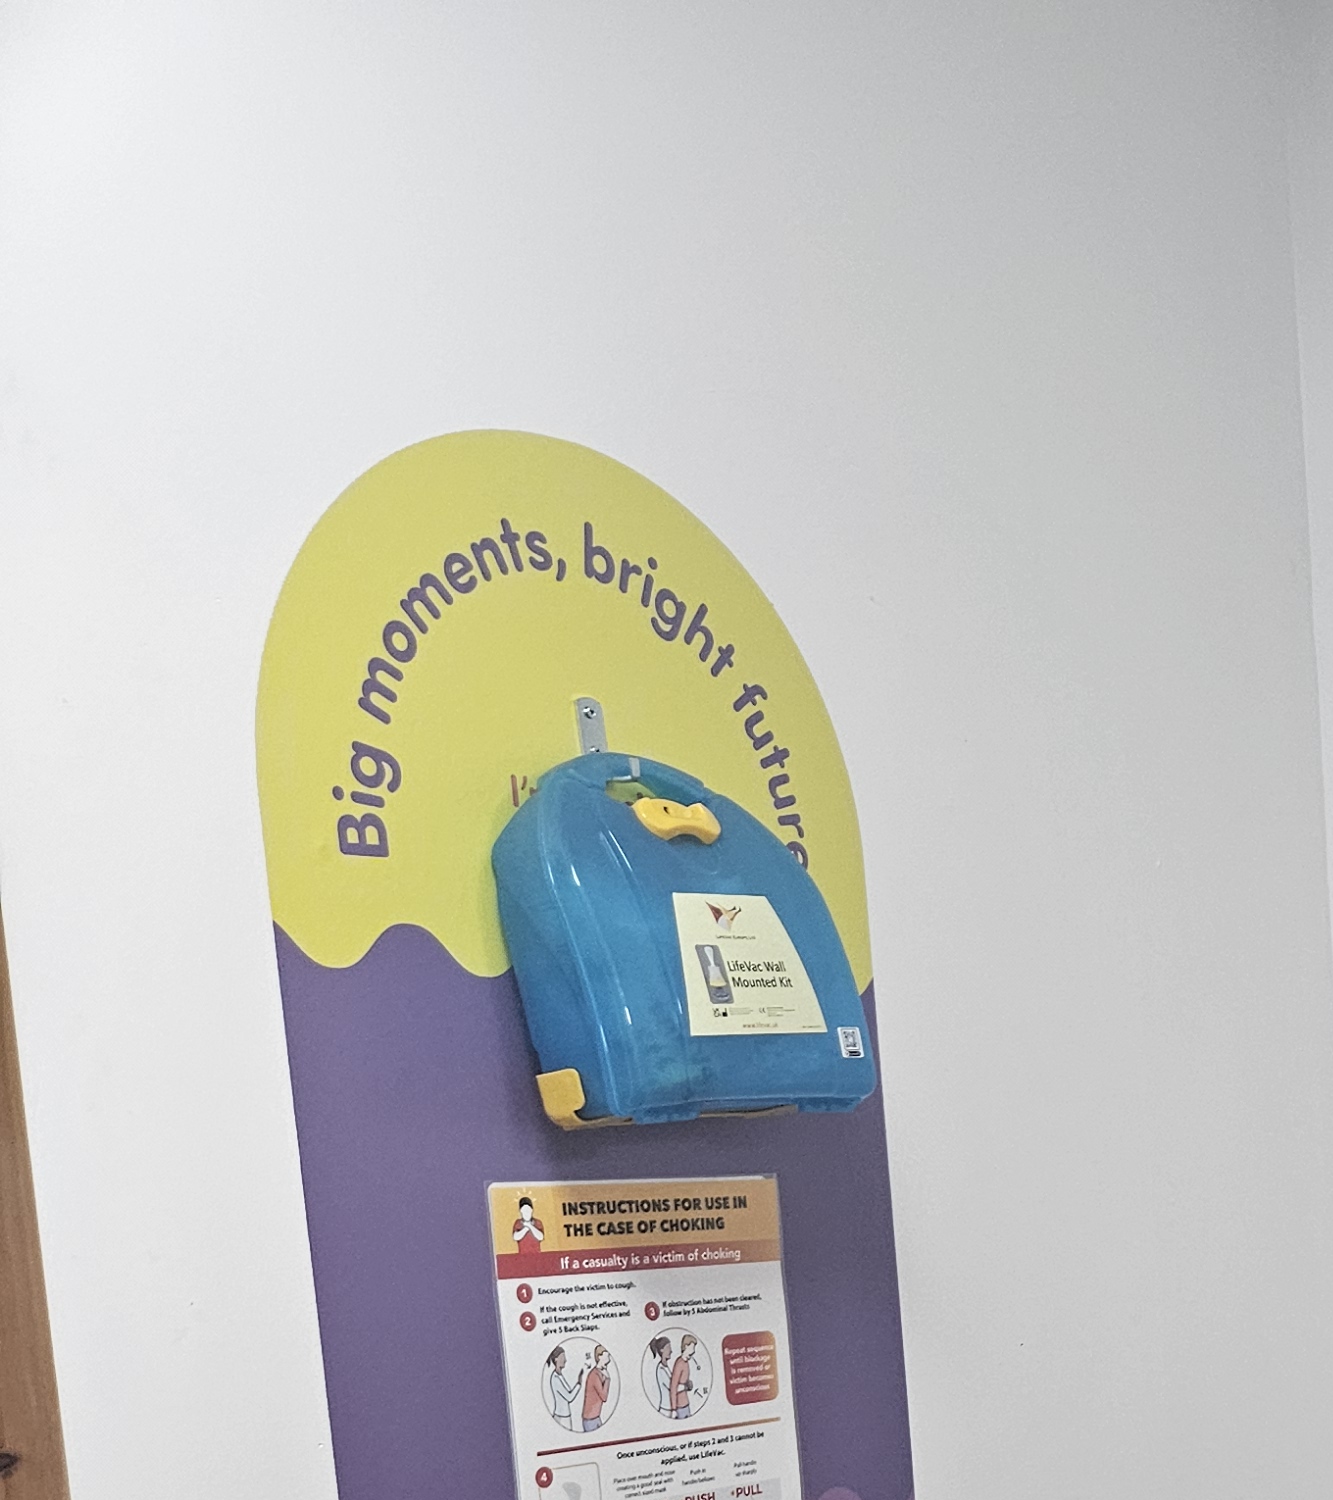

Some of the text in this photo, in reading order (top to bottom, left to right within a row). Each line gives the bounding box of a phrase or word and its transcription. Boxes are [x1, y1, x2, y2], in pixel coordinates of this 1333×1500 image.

[332, 518, 809, 871] Big moments, bright future
[727, 961, 787, 973] LifeVac Wall
[732, 976, 793, 988] Mounted Kit
[562, 1195, 748, 1216] INSTRUCTIONS FOR USE IN
[564, 1216, 725, 1237] THE CASE OF CHOKING
[560, 1247, 742, 1270] If a casualty is a victim of choking
[521, 1288, 527, 1298] 1
[538, 1287, 573, 1295] Encourage
[574, 1284, 585, 1292] the
[586, 1283, 606, 1291] victim
[546, 1305, 557, 1313] the
[558, 1303, 579, 1312] cough
[587, 1301, 598, 1309] not
[650, 1307, 656, 1317] 3
[525, 1316, 531, 1326] 2
[541, 1309, 631, 1324] call Emergency Services and
[543, 1328, 557, 1336] give
[558, 1326, 563, 1334] 5
[564, 1325, 580, 1333] Back
[617, 1450, 634, 1460] Once
[687, 1440, 693, 1449] if
[693, 1439, 711, 1450] steps
[711, 1437, 716, 1445] 2
[717, 1436, 729, 1445] and
[730, 1434, 734, 1443] 3
[735, 1432, 756, 1442] cannot
[757, 1431, 765, 1439] be
[689, 1453, 700, 1461] use
[540, 1472, 548, 1483] 4
[735, 1484, 763, 1498] PULL
